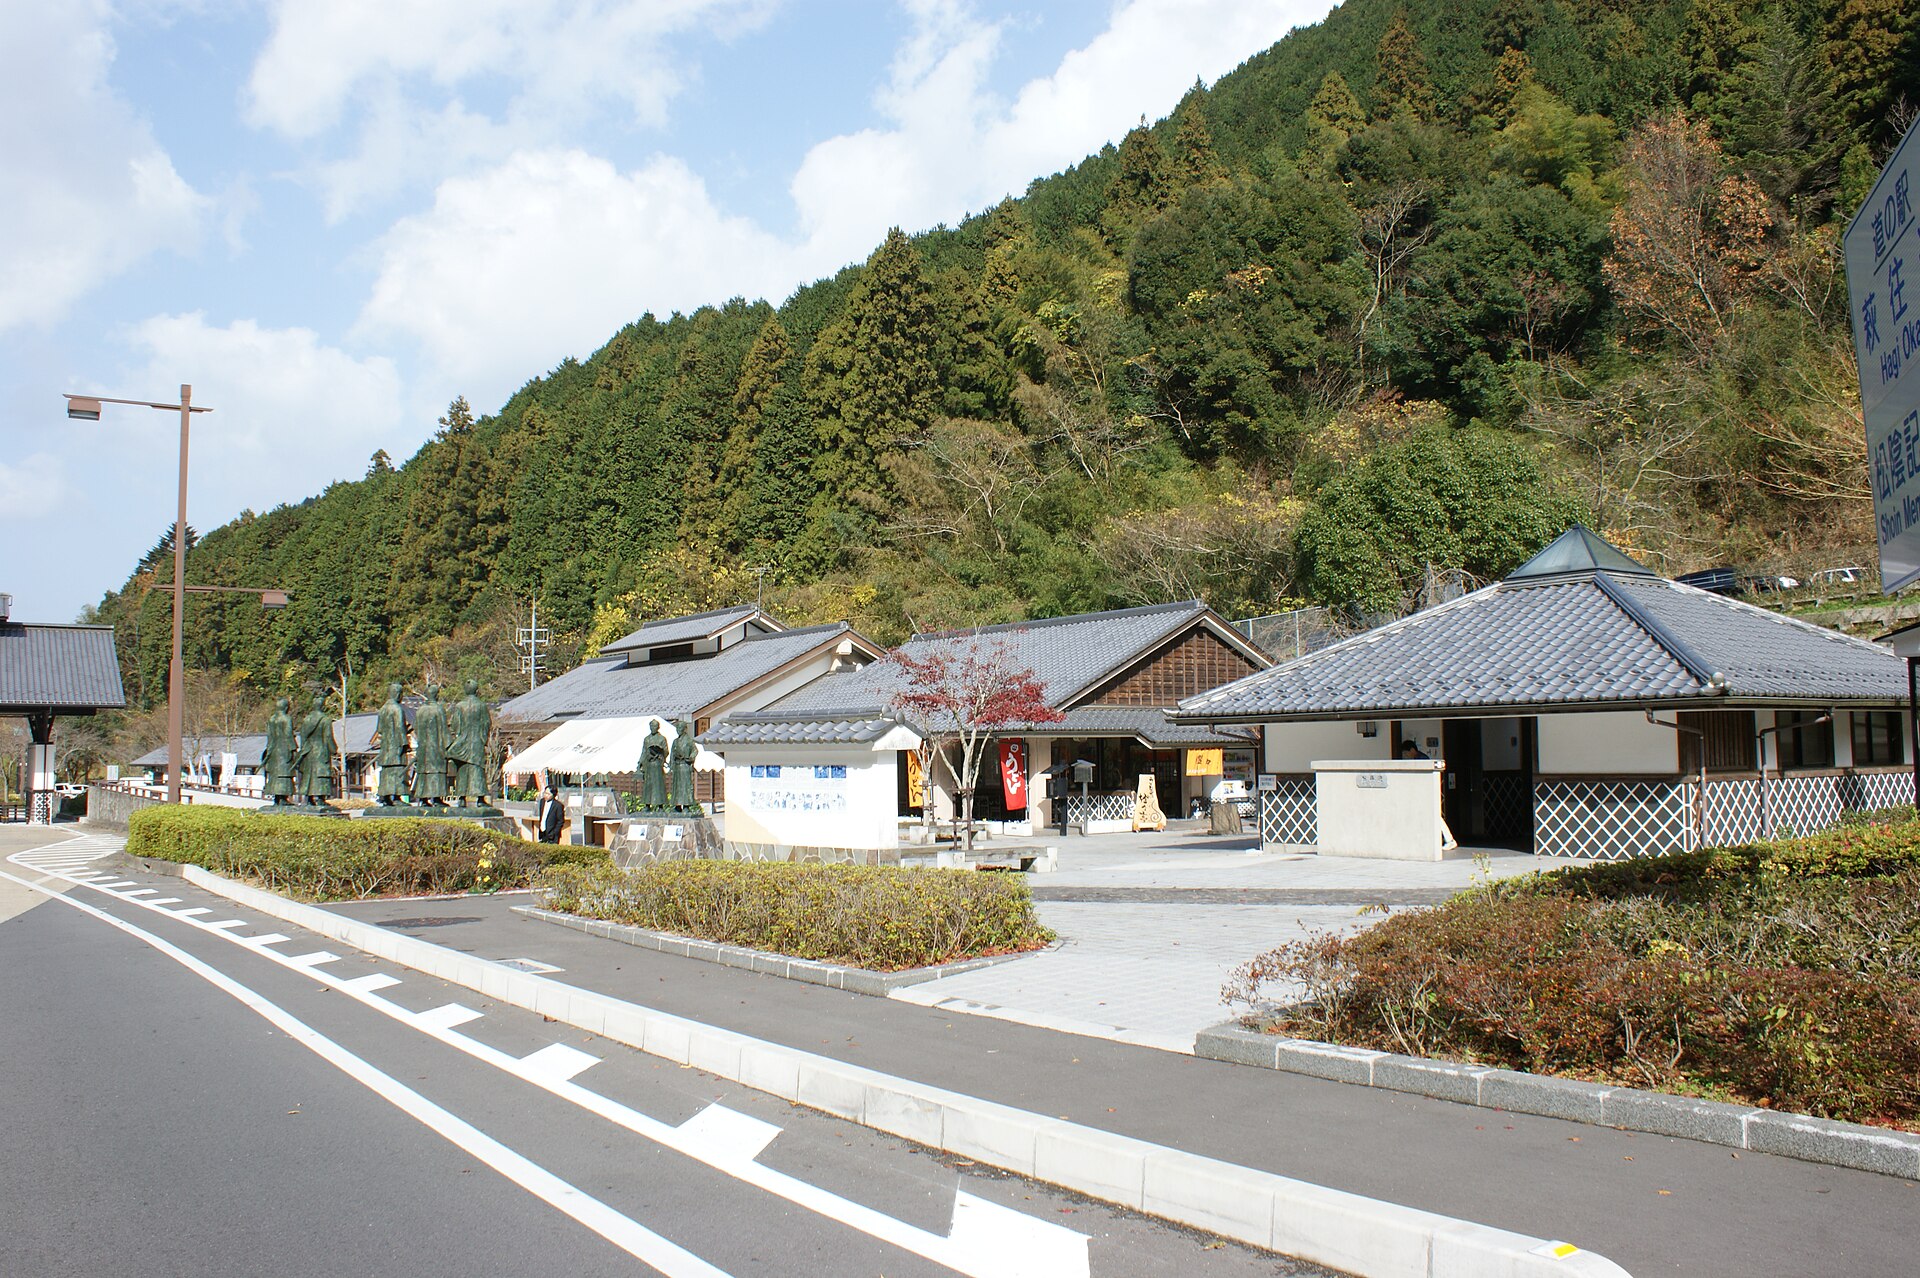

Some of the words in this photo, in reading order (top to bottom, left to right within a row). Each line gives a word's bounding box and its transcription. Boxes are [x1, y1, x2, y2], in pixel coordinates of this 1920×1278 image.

[1871, 168, 1912, 262] 道の駅
[1862, 227, 1920, 355] 萩往
[1880, 335, 1901, 385] Hagi
[1880, 507, 1903, 546] Shoin
[1005, 752, 1022, 795] うどん
